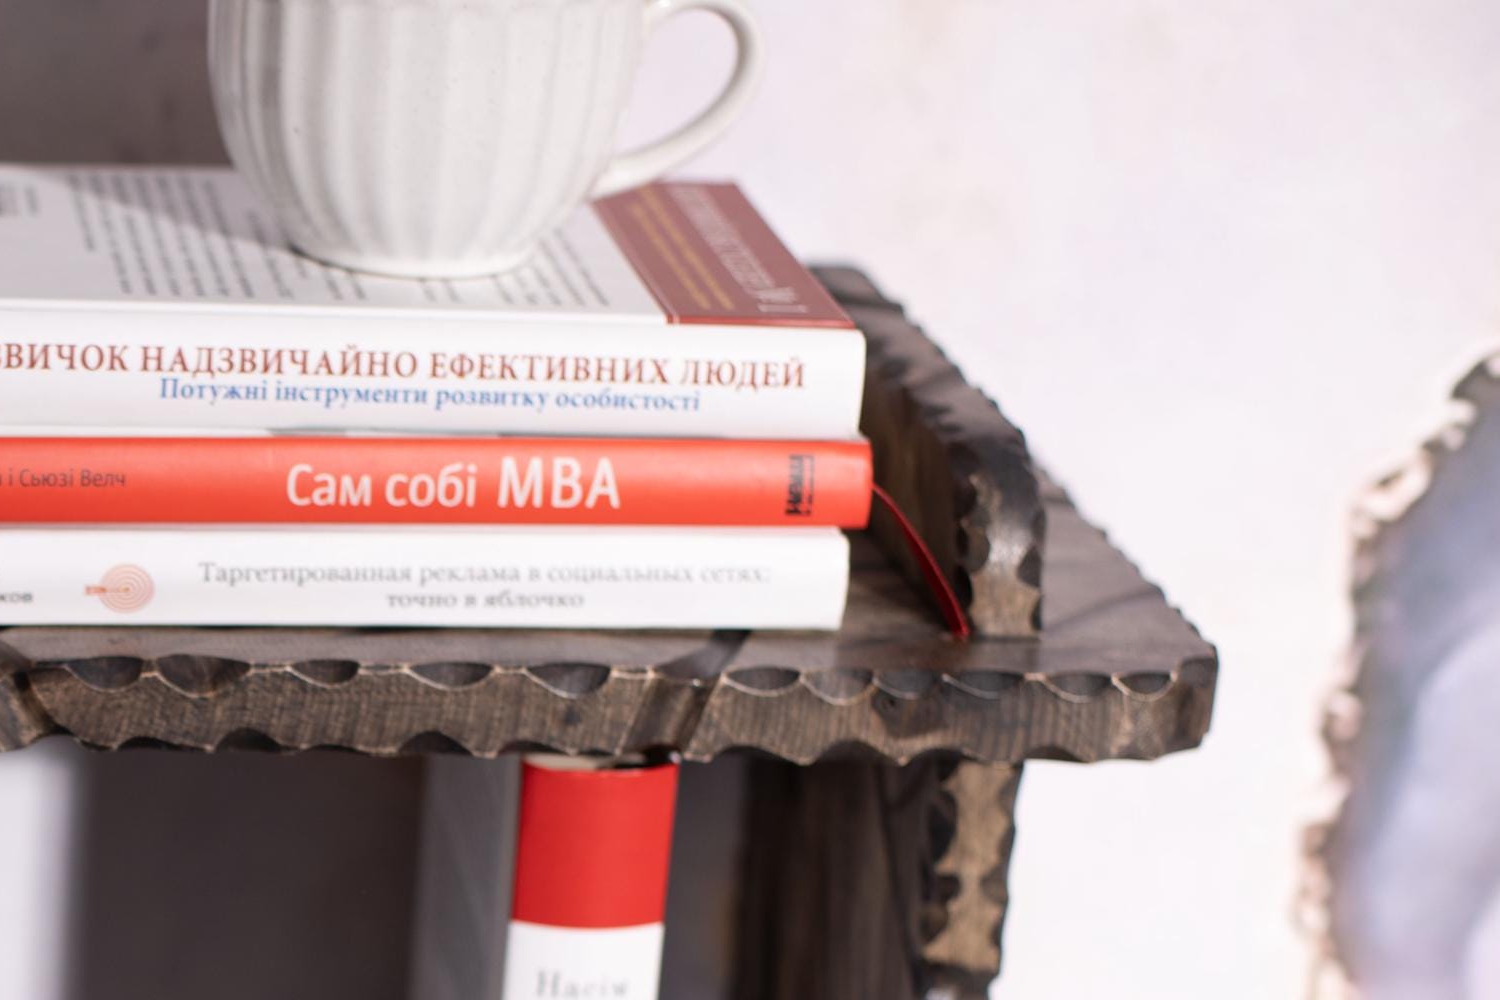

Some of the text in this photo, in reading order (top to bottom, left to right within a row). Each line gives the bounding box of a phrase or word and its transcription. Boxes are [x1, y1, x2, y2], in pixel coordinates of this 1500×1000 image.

[140, 343, 418, 379] НАДЗВИЧАЙНО
[428, 352, 672, 386] ЕФЕКТИВНИХ
[678, 354, 806, 390] ЛЮДЕЙ
[159, 376, 701, 413] Потужні інструменти розвитку особистості
[7, 468, 15, 487] і
[18, 468, 75, 488] Сьюзі
[80, 469, 127, 488] Велч
[286, 456, 621, 509] Сам собі MBA
[198, 561, 412, 587] Таргетированная
[419, 567, 521, 587] реклама
[527, 567, 542, 583] в
[547, 567, 695, 584] социальных
[386, 588, 585, 608] точно в яблочко
